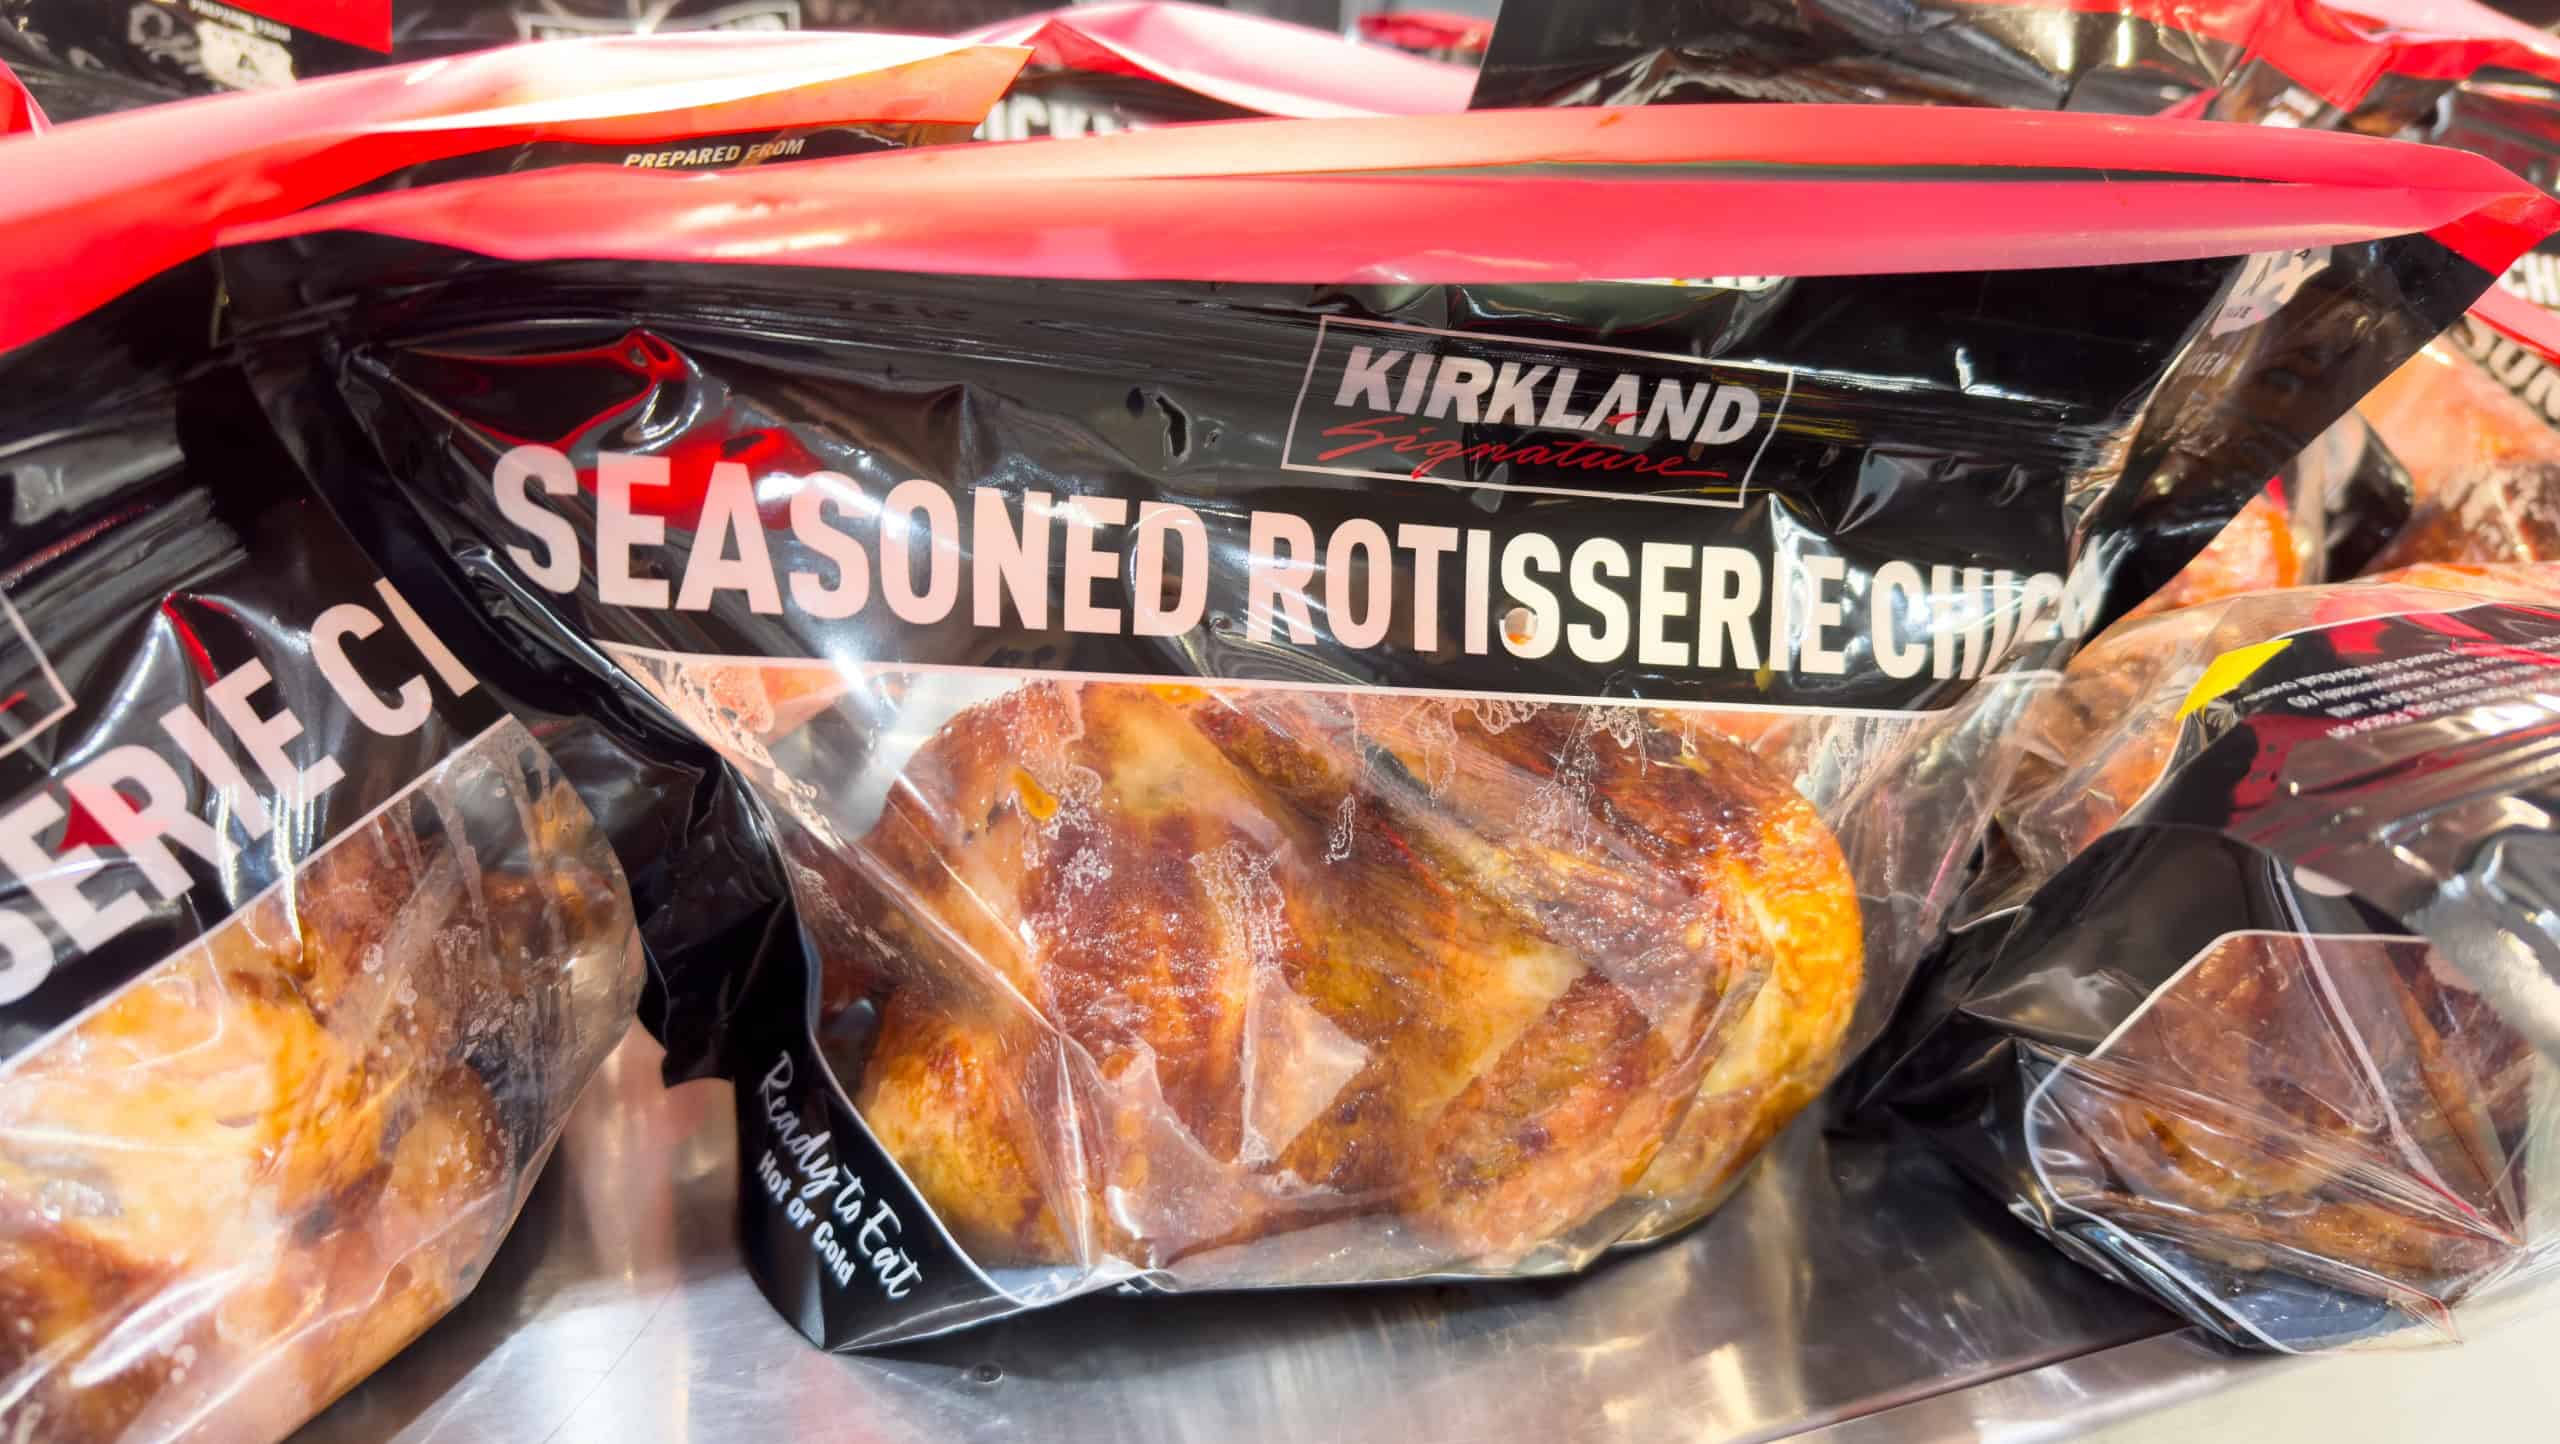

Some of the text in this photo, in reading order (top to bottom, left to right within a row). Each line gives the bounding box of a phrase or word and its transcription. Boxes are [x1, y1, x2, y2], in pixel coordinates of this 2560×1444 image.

[624, 139, 805, 168] PREPARED FROM
[1318, 416, 1728, 480] Signature
[1334, 346, 1760, 446] KIRKLAND
[492, 445, 1209, 638] SEASONED
[1247, 511, 1847, 674] ROTISSERIE
[757, 1050, 923, 1299] Ready to Eat
[757, 1150, 857, 1288] Hot or Cold
